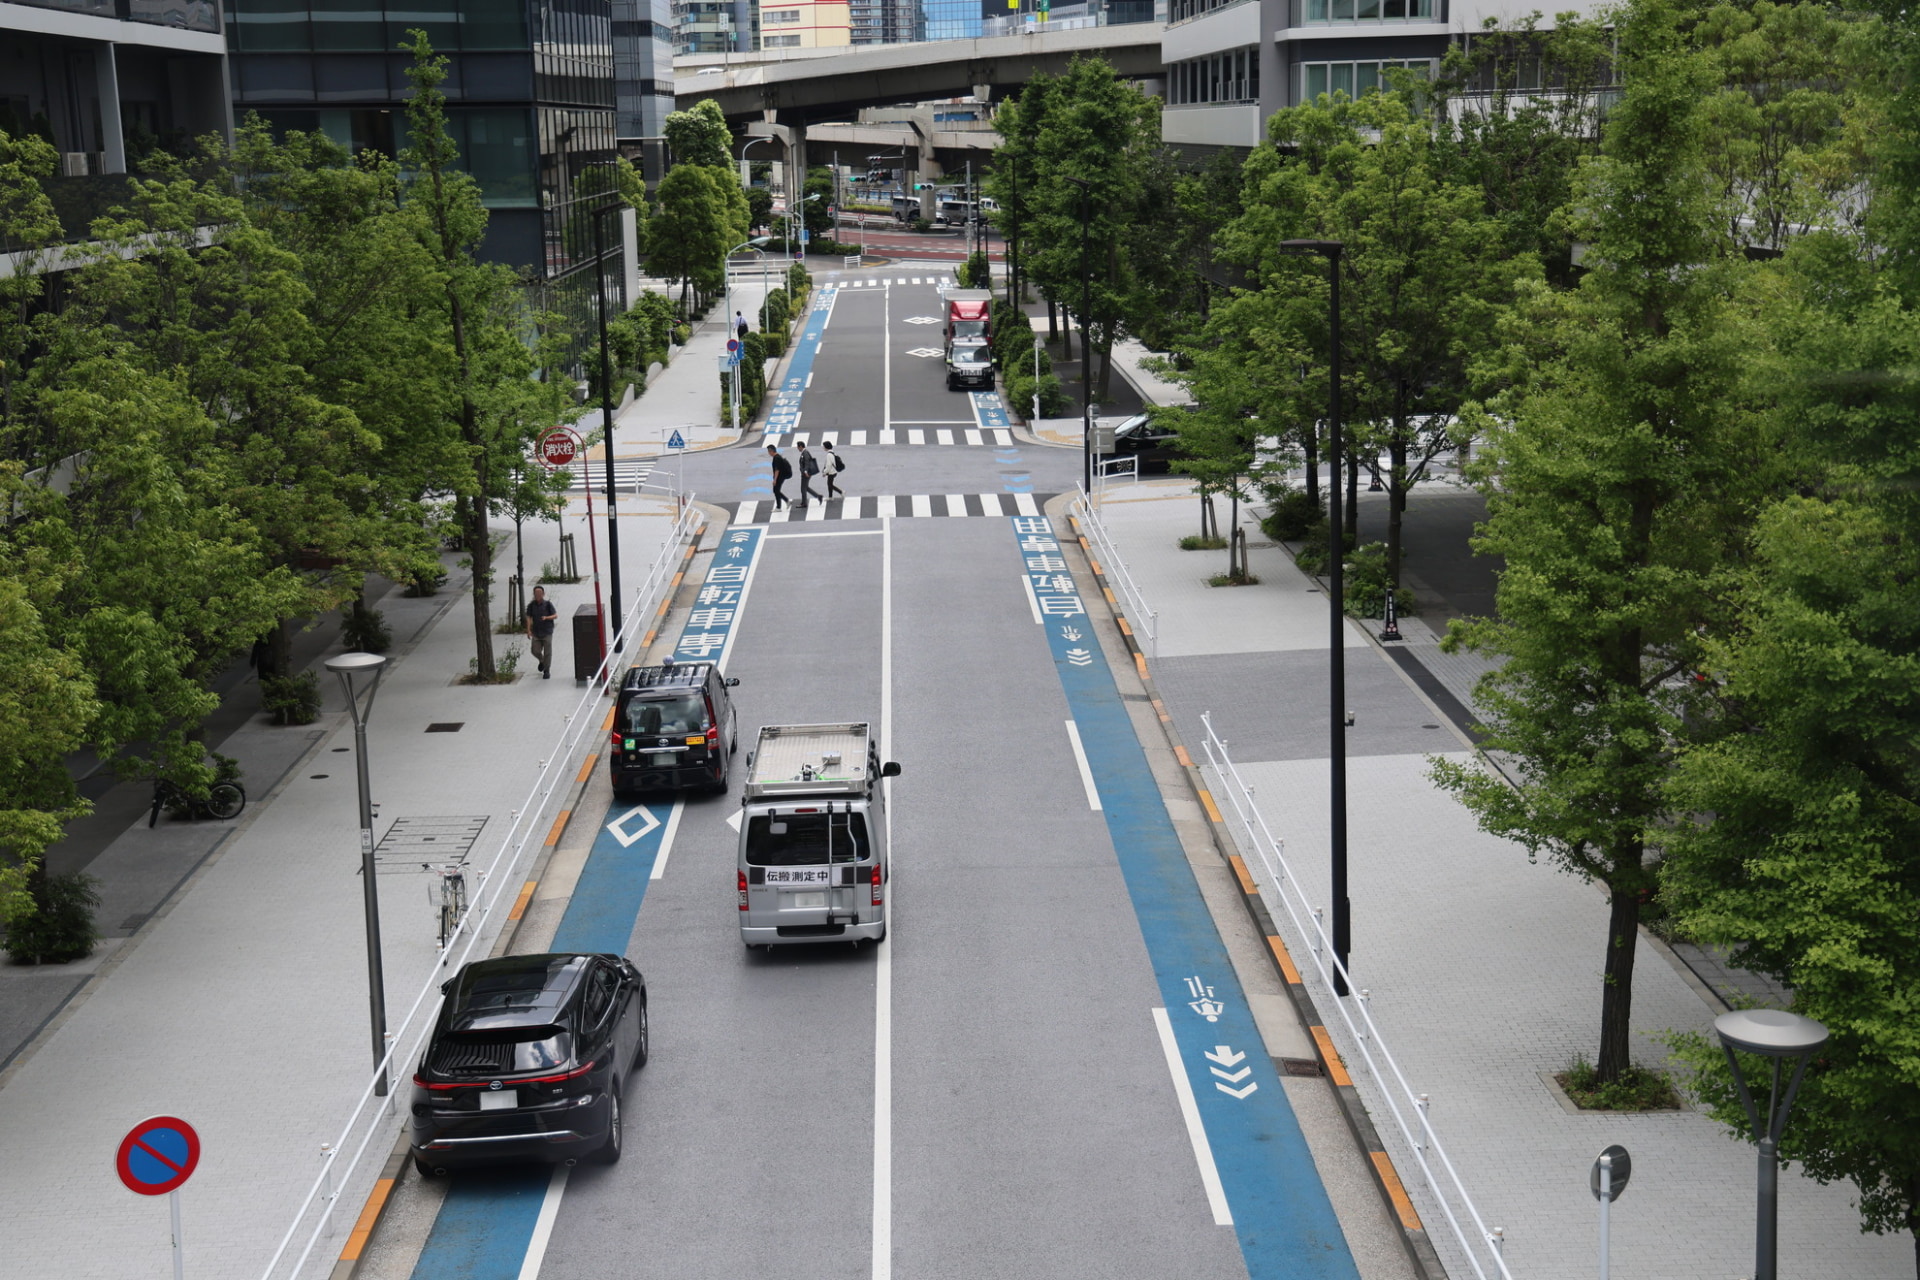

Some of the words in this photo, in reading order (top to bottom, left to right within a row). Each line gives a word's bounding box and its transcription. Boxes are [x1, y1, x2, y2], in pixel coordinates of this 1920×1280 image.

[545, 442, 574, 457] 消火栓
[1013, 518, 1085, 618] 自転車専用
[674, 563, 748, 665] 自転車専
[767, 871, 828, 882] 伝搬測定中
